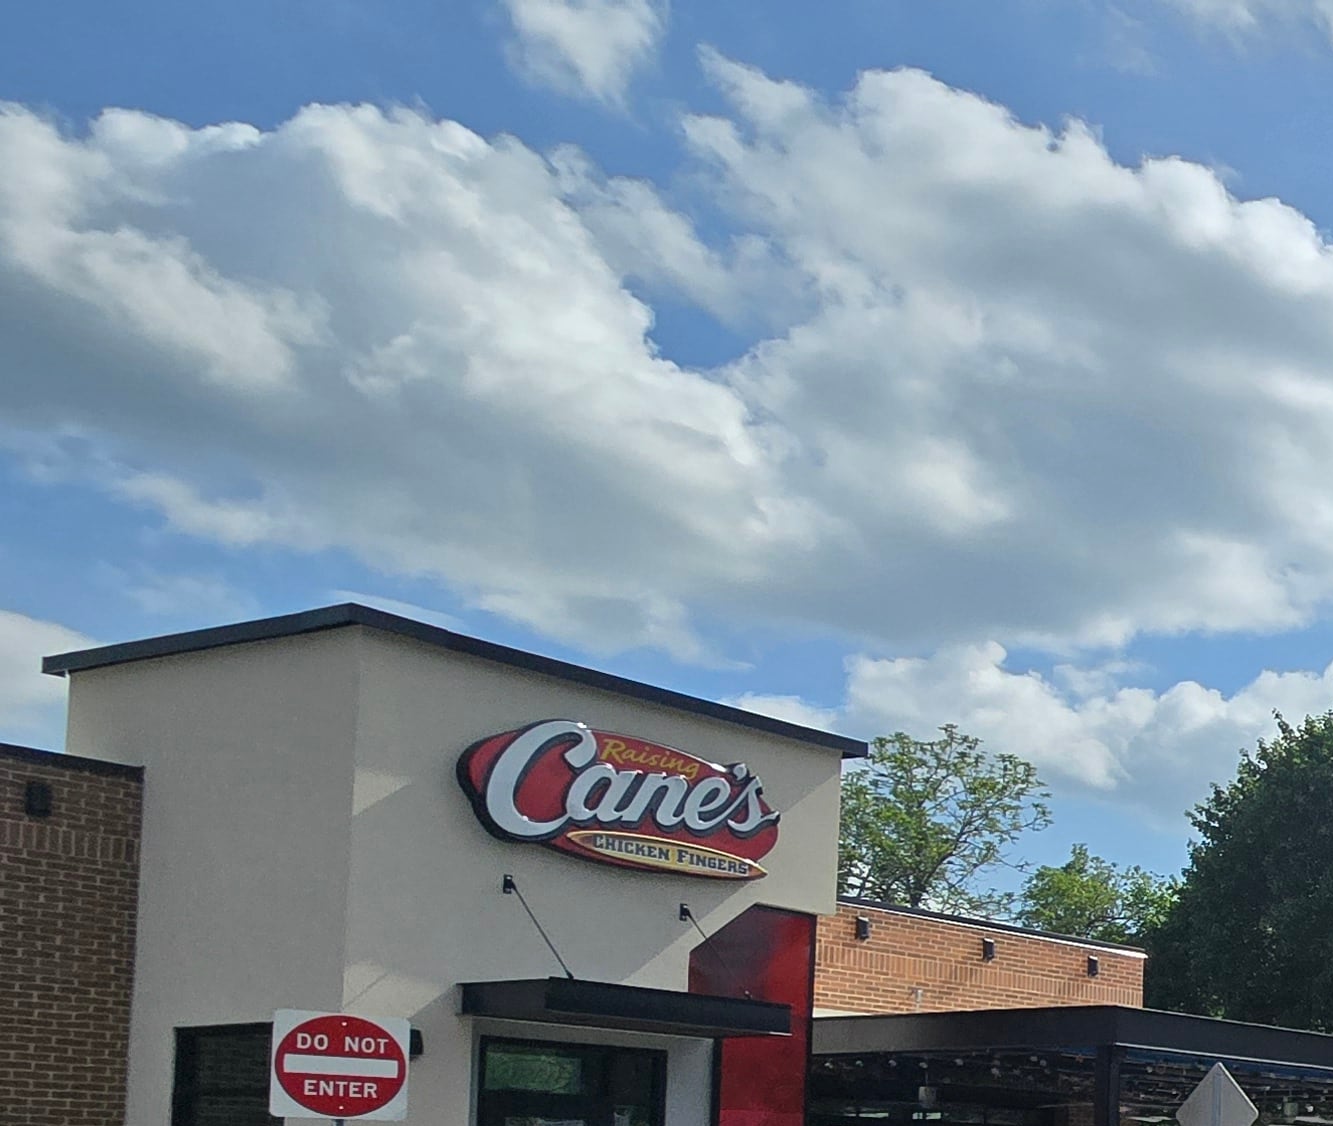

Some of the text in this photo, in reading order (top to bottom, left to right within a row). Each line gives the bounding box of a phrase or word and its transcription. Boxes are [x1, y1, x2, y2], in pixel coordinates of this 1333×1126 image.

[600, 738, 700, 780] Raising
[486, 719, 780, 839] Cane's
[296, 1032, 389, 1054] DO NOT
[304, 1079, 378, 1099] ENTER
